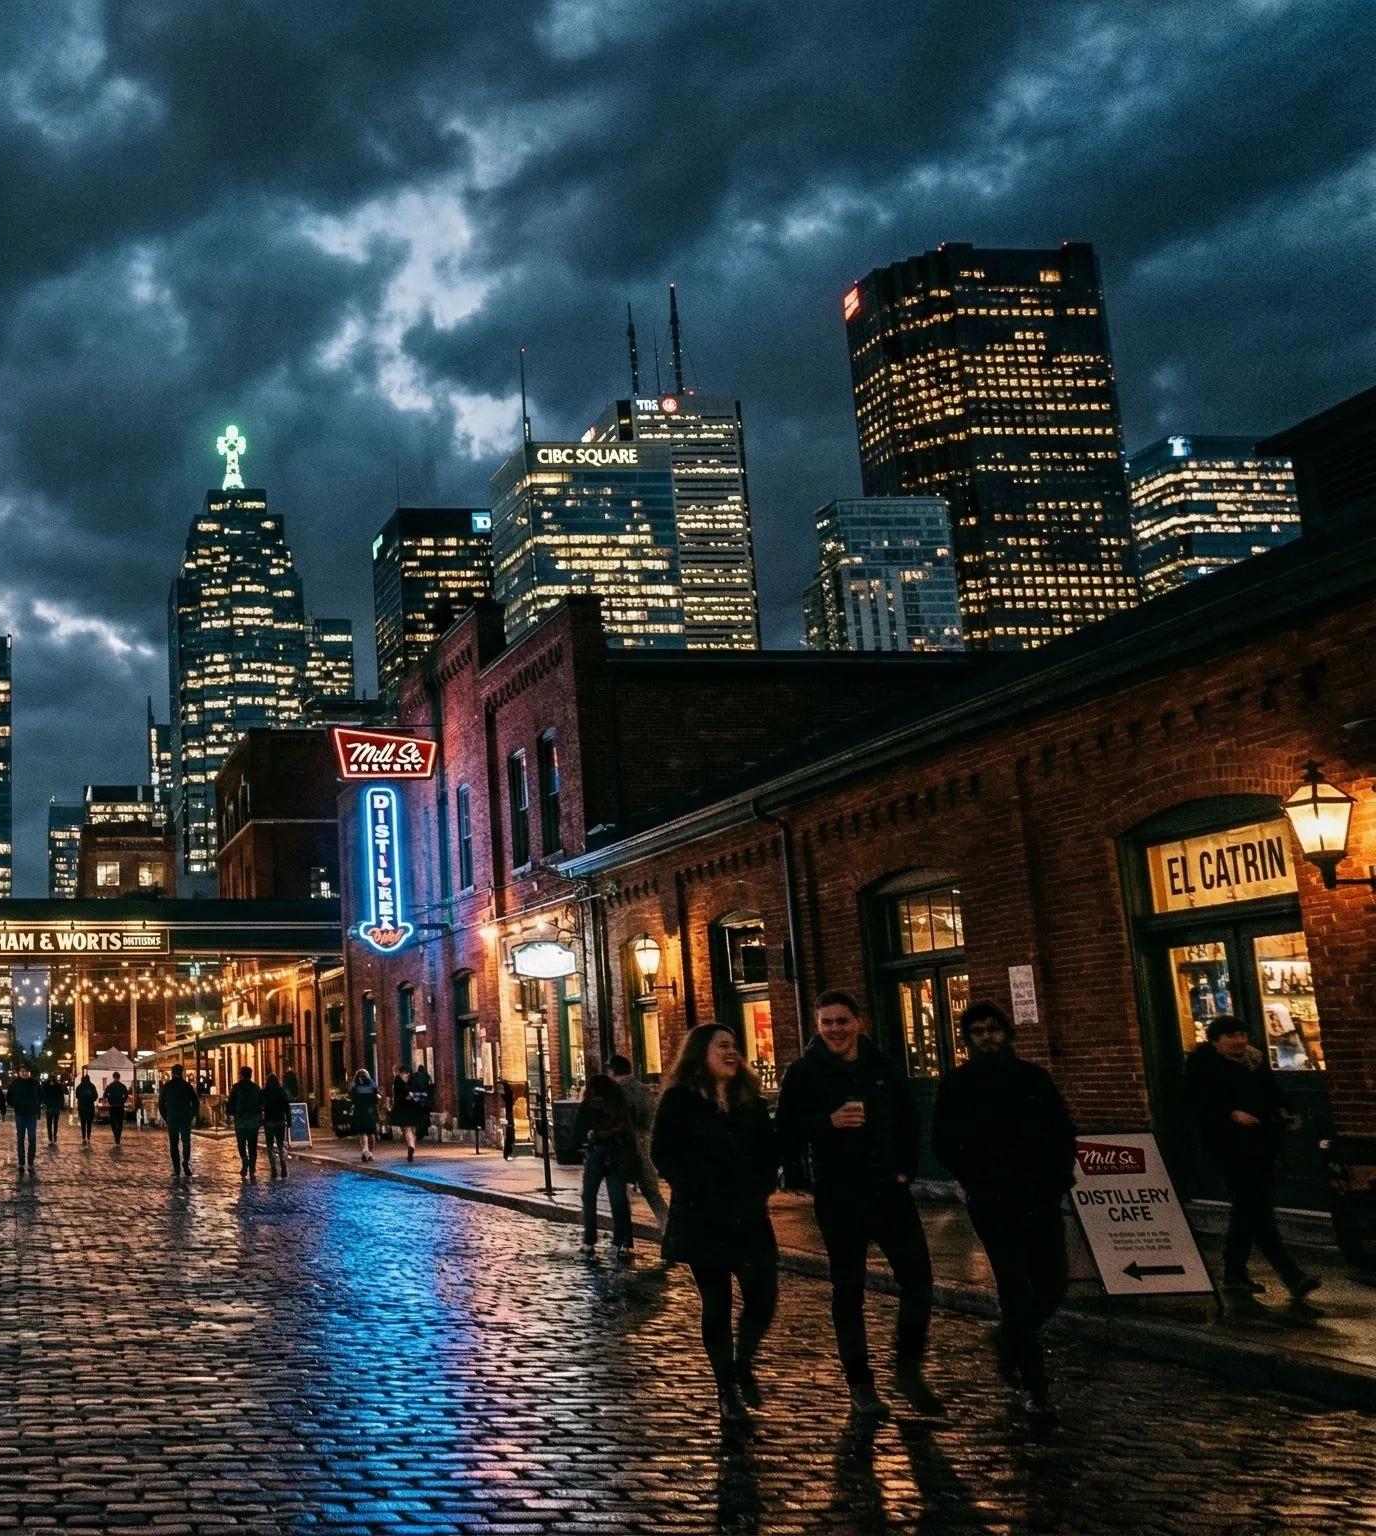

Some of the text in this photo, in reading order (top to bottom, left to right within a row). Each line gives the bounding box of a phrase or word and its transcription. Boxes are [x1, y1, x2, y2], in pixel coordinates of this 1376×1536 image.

[537, 448, 638, 467] CIBC SQUARE
[346, 742, 396, 763] Mill
[1166, 836, 1288, 896] EL CATRIN
[40, 932, 54, 951] &
[56, 932, 122, 951] WORTS
[1076, 1188, 1170, 1206] DISTILLERY
[1108, 1206, 1154, 1222] CAFE
